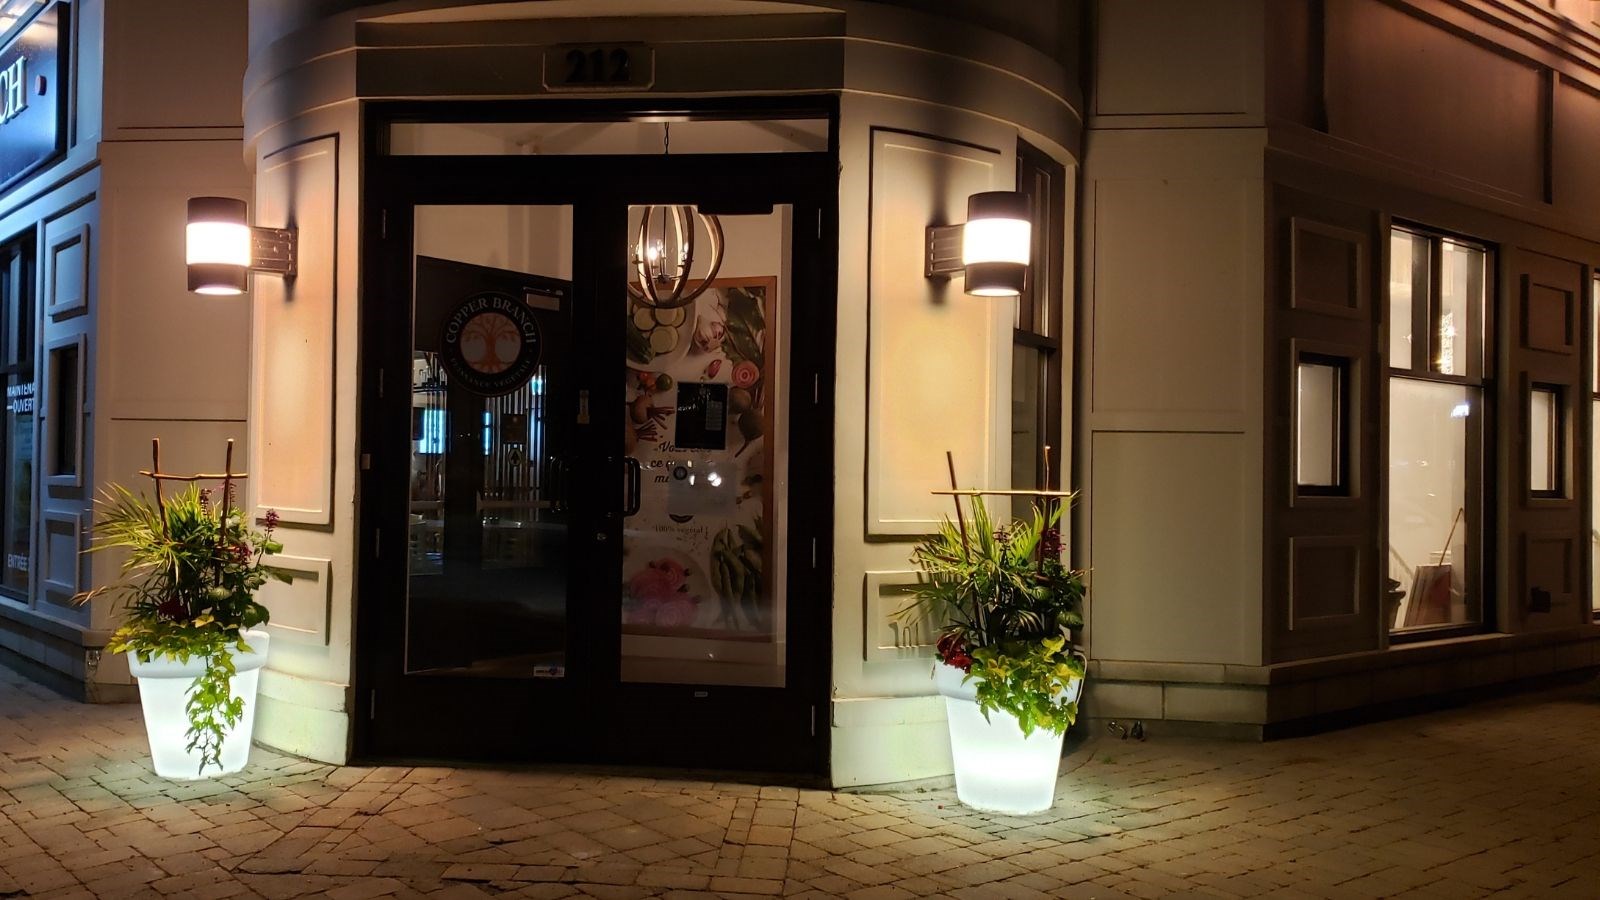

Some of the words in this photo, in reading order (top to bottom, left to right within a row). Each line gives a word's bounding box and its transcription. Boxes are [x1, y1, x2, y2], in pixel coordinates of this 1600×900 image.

[565, 48, 631, 83] 212
[446, 297, 489, 344] COPPER
[493, 297, 537, 344] BRANCH
